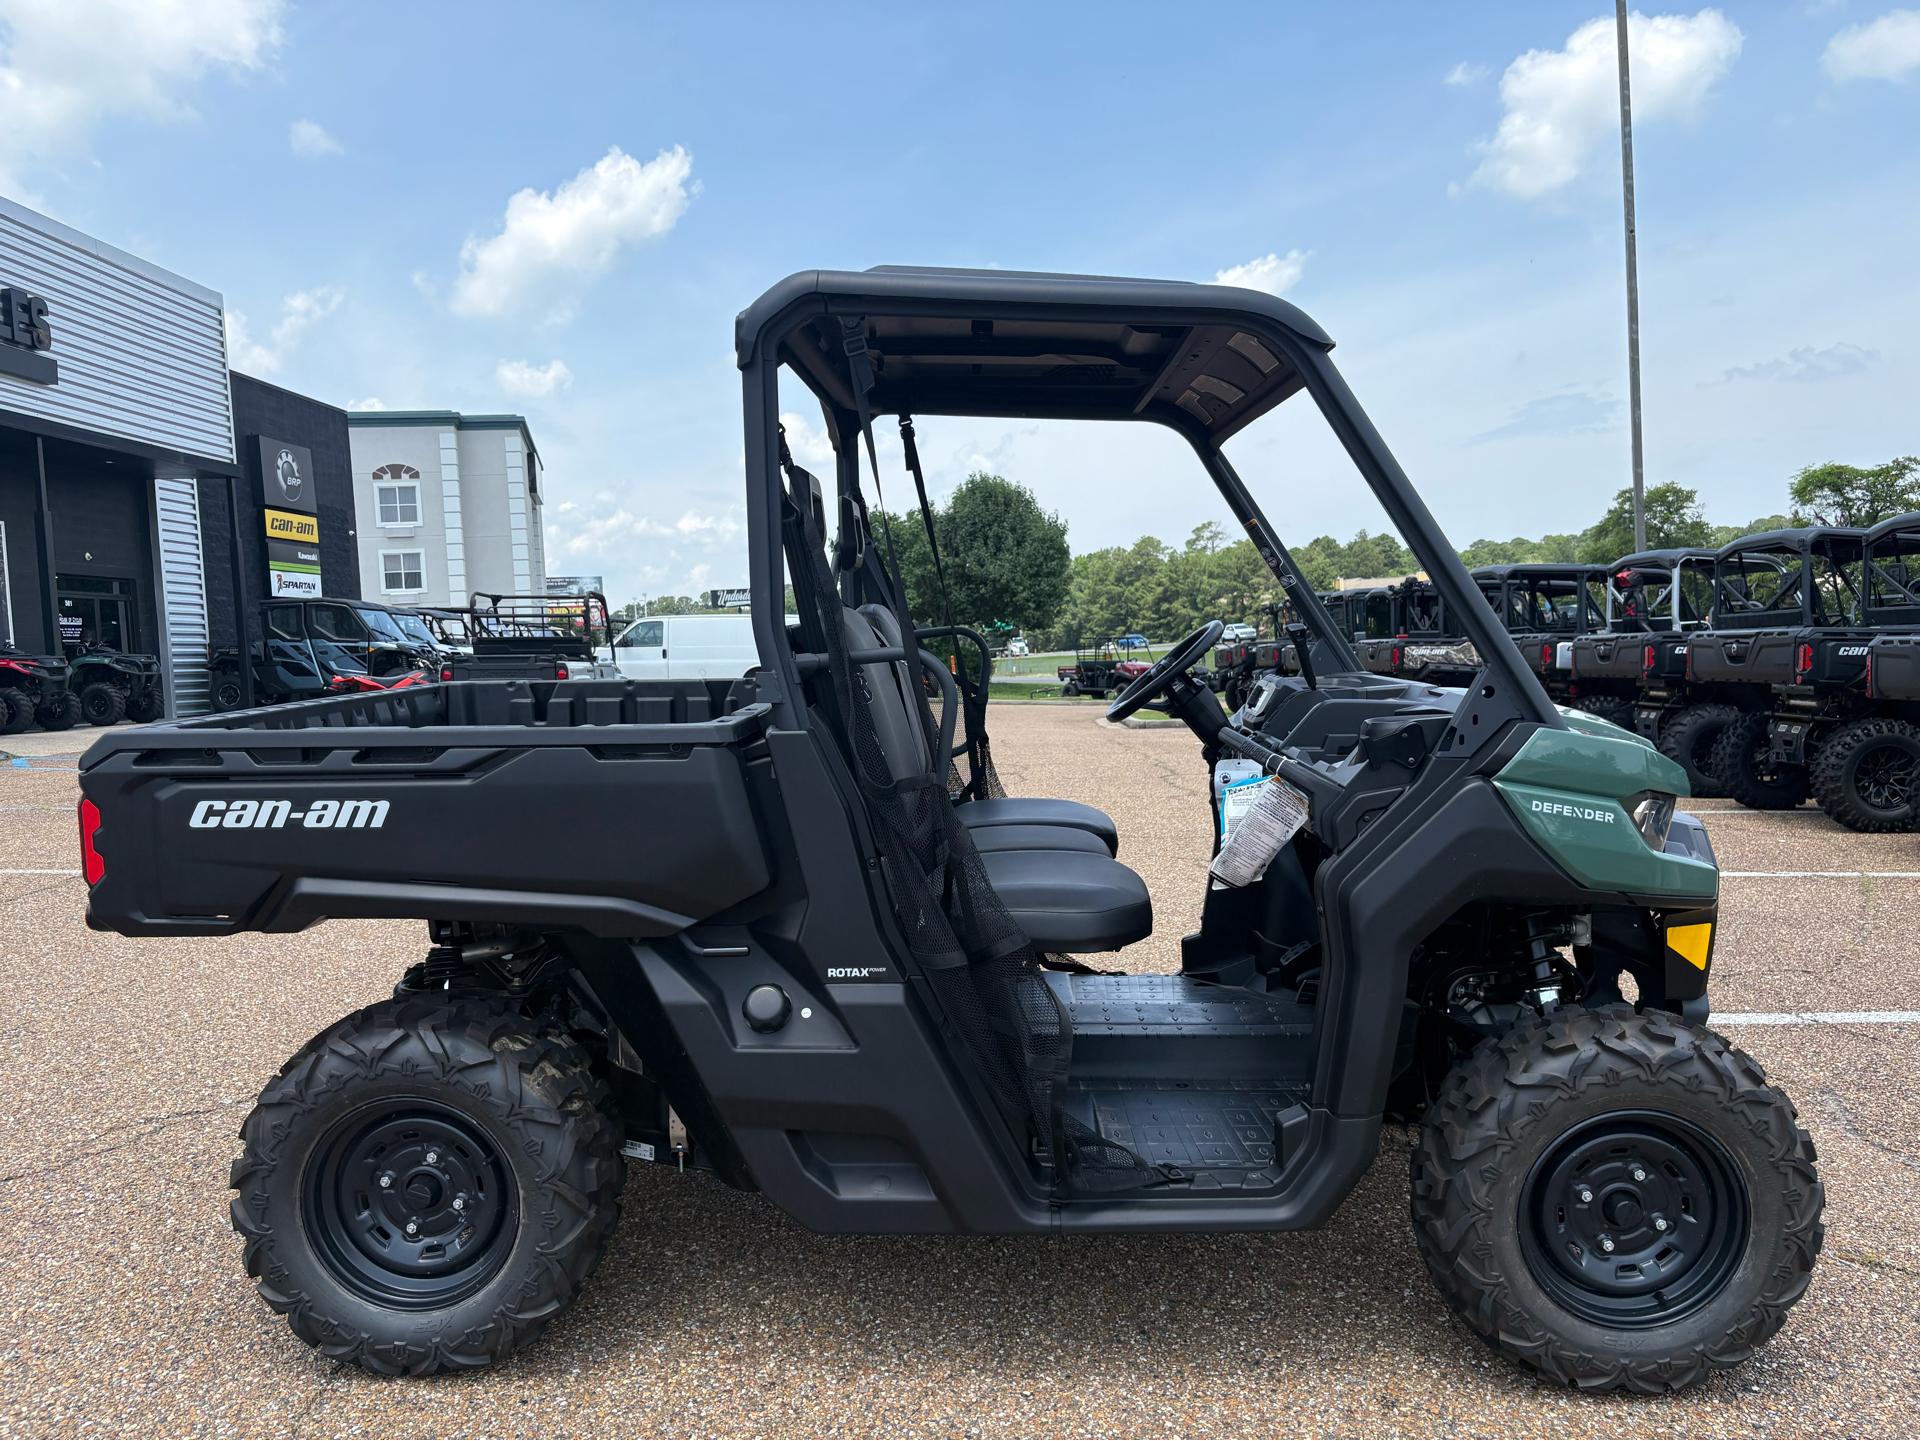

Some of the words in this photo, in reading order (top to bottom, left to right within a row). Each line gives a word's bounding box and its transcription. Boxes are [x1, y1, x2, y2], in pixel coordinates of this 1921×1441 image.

[287, 476, 301, 487] BRP
[270, 517, 314, 536] can-am
[282, 580, 316, 591] SPARTAN
[717, 589, 750, 606] Underd
[1838, 646, 1868, 656] can
[189, 800, 391, 828] can-am
[1531, 800, 1615, 824] DEFENDER
[827, 967, 869, 978] ROTAX
